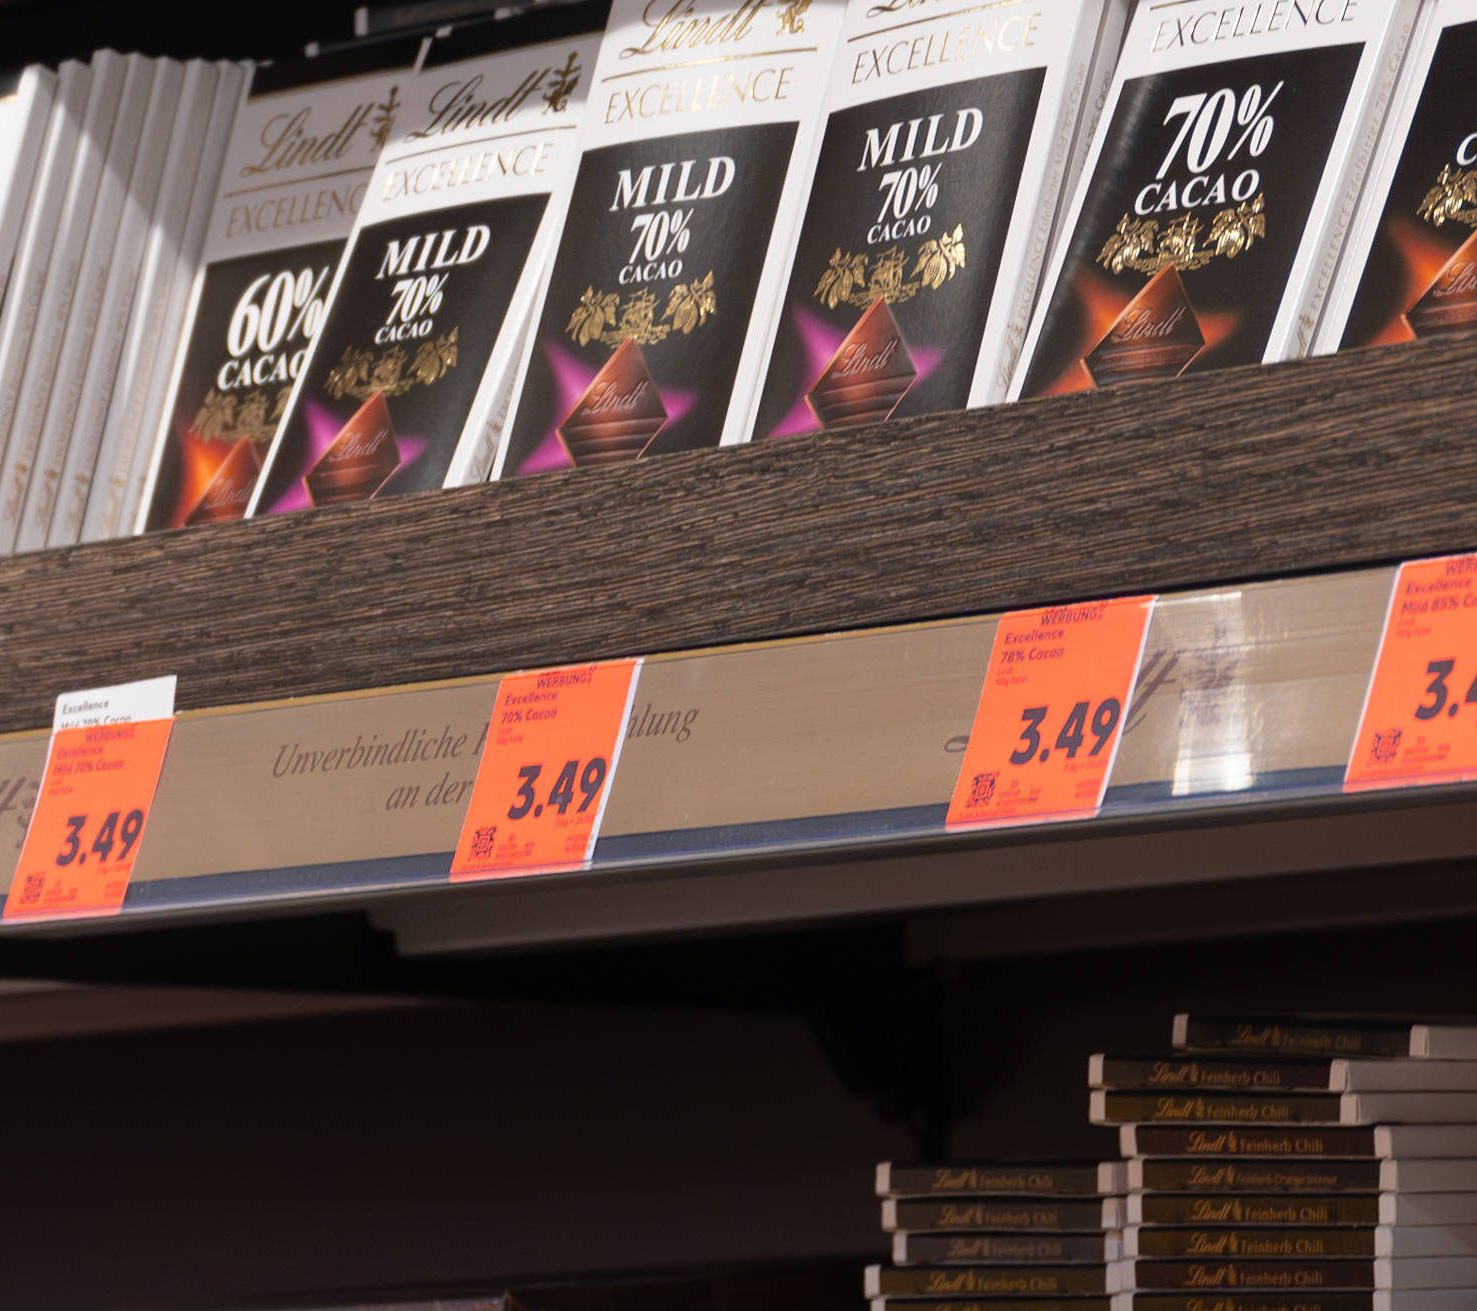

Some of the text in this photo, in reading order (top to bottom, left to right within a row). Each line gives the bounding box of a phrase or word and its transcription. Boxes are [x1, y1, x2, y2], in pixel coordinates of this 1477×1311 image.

[856, 107, 984, 173] MILD
[1156, 80, 1284, 180] 70%
[609, 155, 736, 214] MILD
[877, 163, 943, 223] 70%
[1134, 170, 1260, 217] CACAO
[375, 226, 491, 281] MILD
[628, 208, 692, 264] 70%
[866, 215, 931, 246] CACAO
[388, 272, 444, 325] 70%
[618, 258, 683, 286] CACAO
[227, 267, 330, 357] 60%
[1000, 645, 1065, 664] 78% Cacao
[1004, 627, 1065, 645] Excellence
[501, 707, 558, 722] 70% Cacao
[1010, 698, 1122, 766] 3.49
[272, 729, 468, 778] Unverbindliche
[507, 757, 608, 820] 3.49
[55, 809, 144, 867] 3.49
